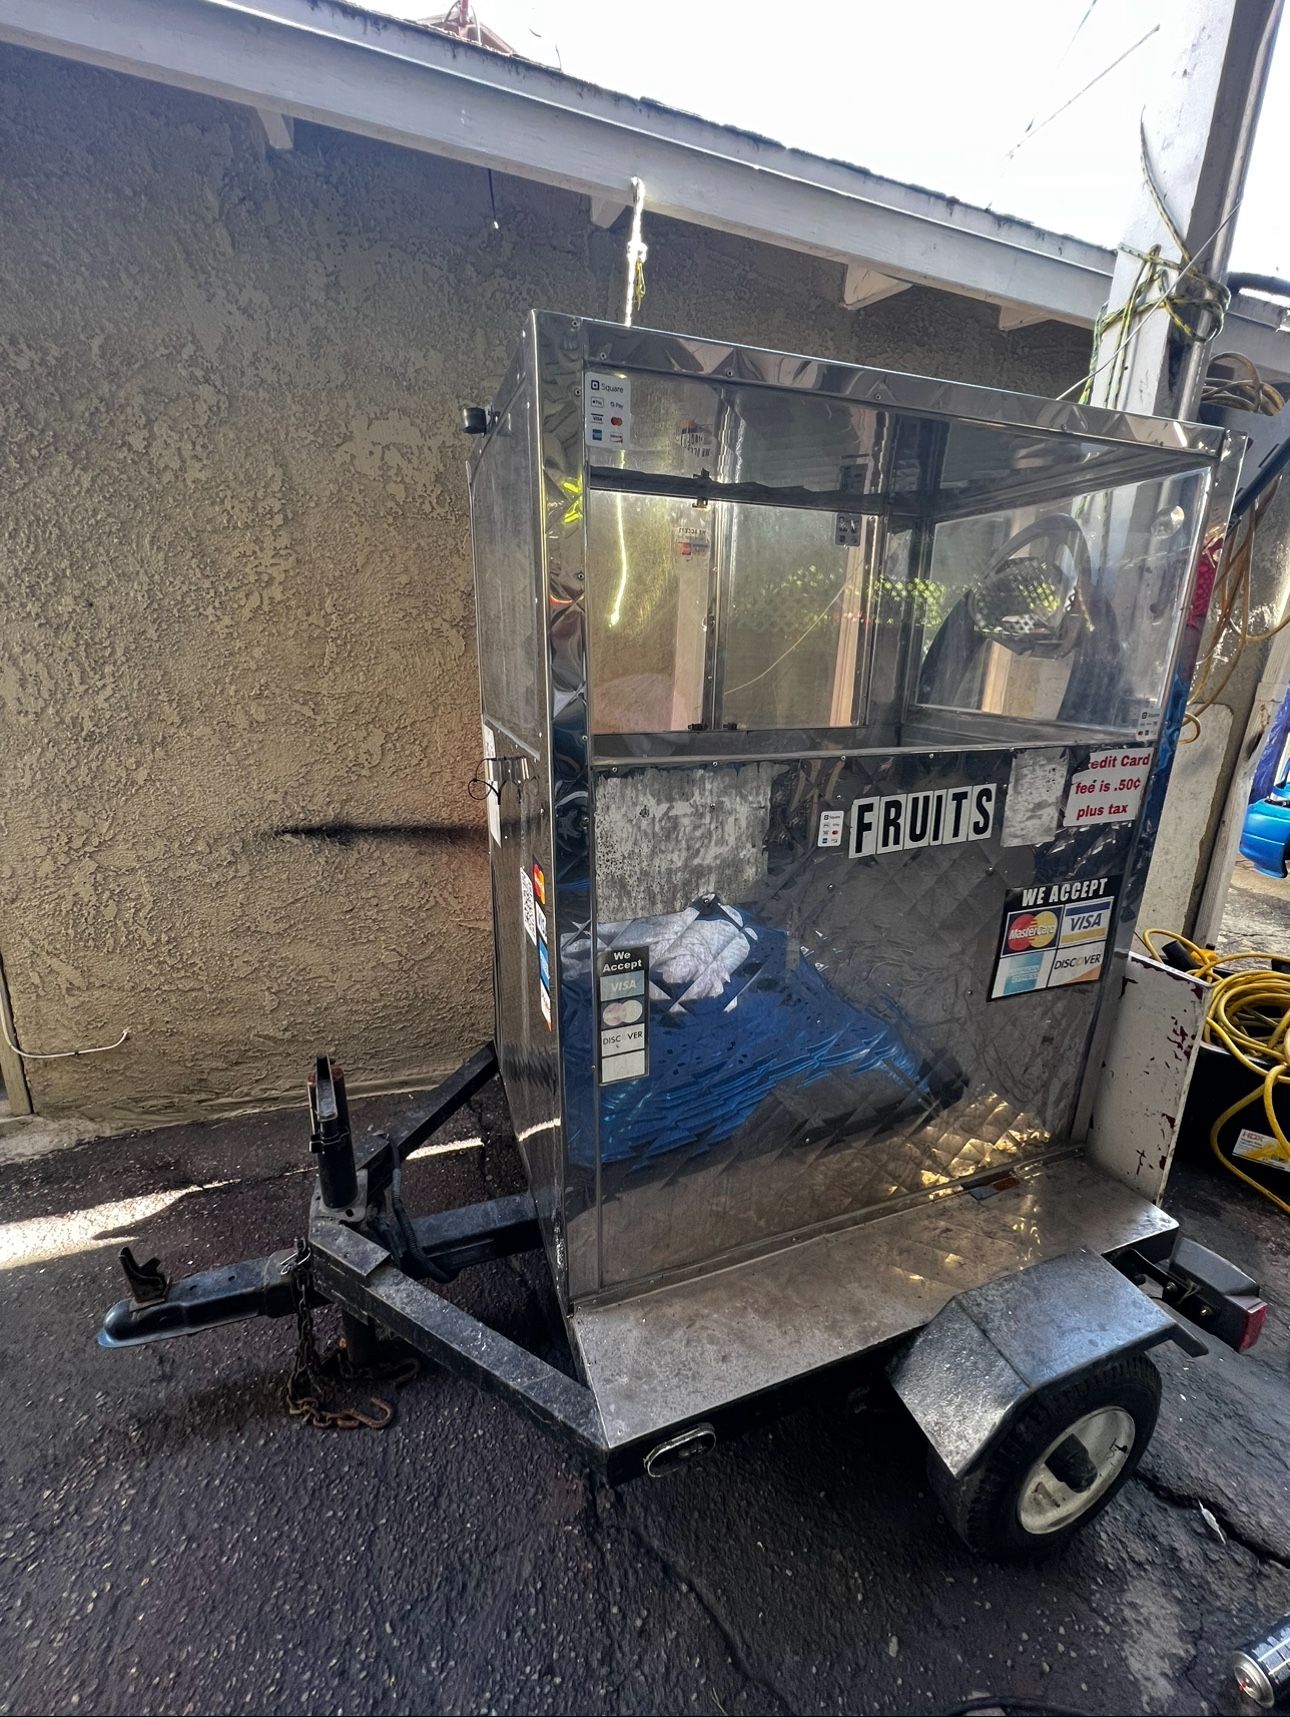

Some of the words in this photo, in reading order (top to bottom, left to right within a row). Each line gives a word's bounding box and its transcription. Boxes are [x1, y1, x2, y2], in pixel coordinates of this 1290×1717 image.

[601, 382, 624, 394] Square
[1088, 755, 1117, 770] edit
[1121, 753, 1151, 767] Card
[1075, 781, 1096, 795] fee
[1099, 780, 1110, 793] is
[1113, 777, 1142, 792] .50¢
[1076, 804, 1105, 820] plus
[1108, 803, 1129, 815] tax
[855, 787, 993, 854] FRUITS
[1021, 886, 1046, 907] WE
[1048, 877, 1108, 903] ACCEPT
[1070, 913, 1103, 932] VISA
[1008, 924, 1056, 940] MasterCard
[613, 951, 631, 961] We
[602, 959, 642, 973] Accept
[611, 979, 638, 992] VISA
[602, 1030, 643, 1046] DISCVER
